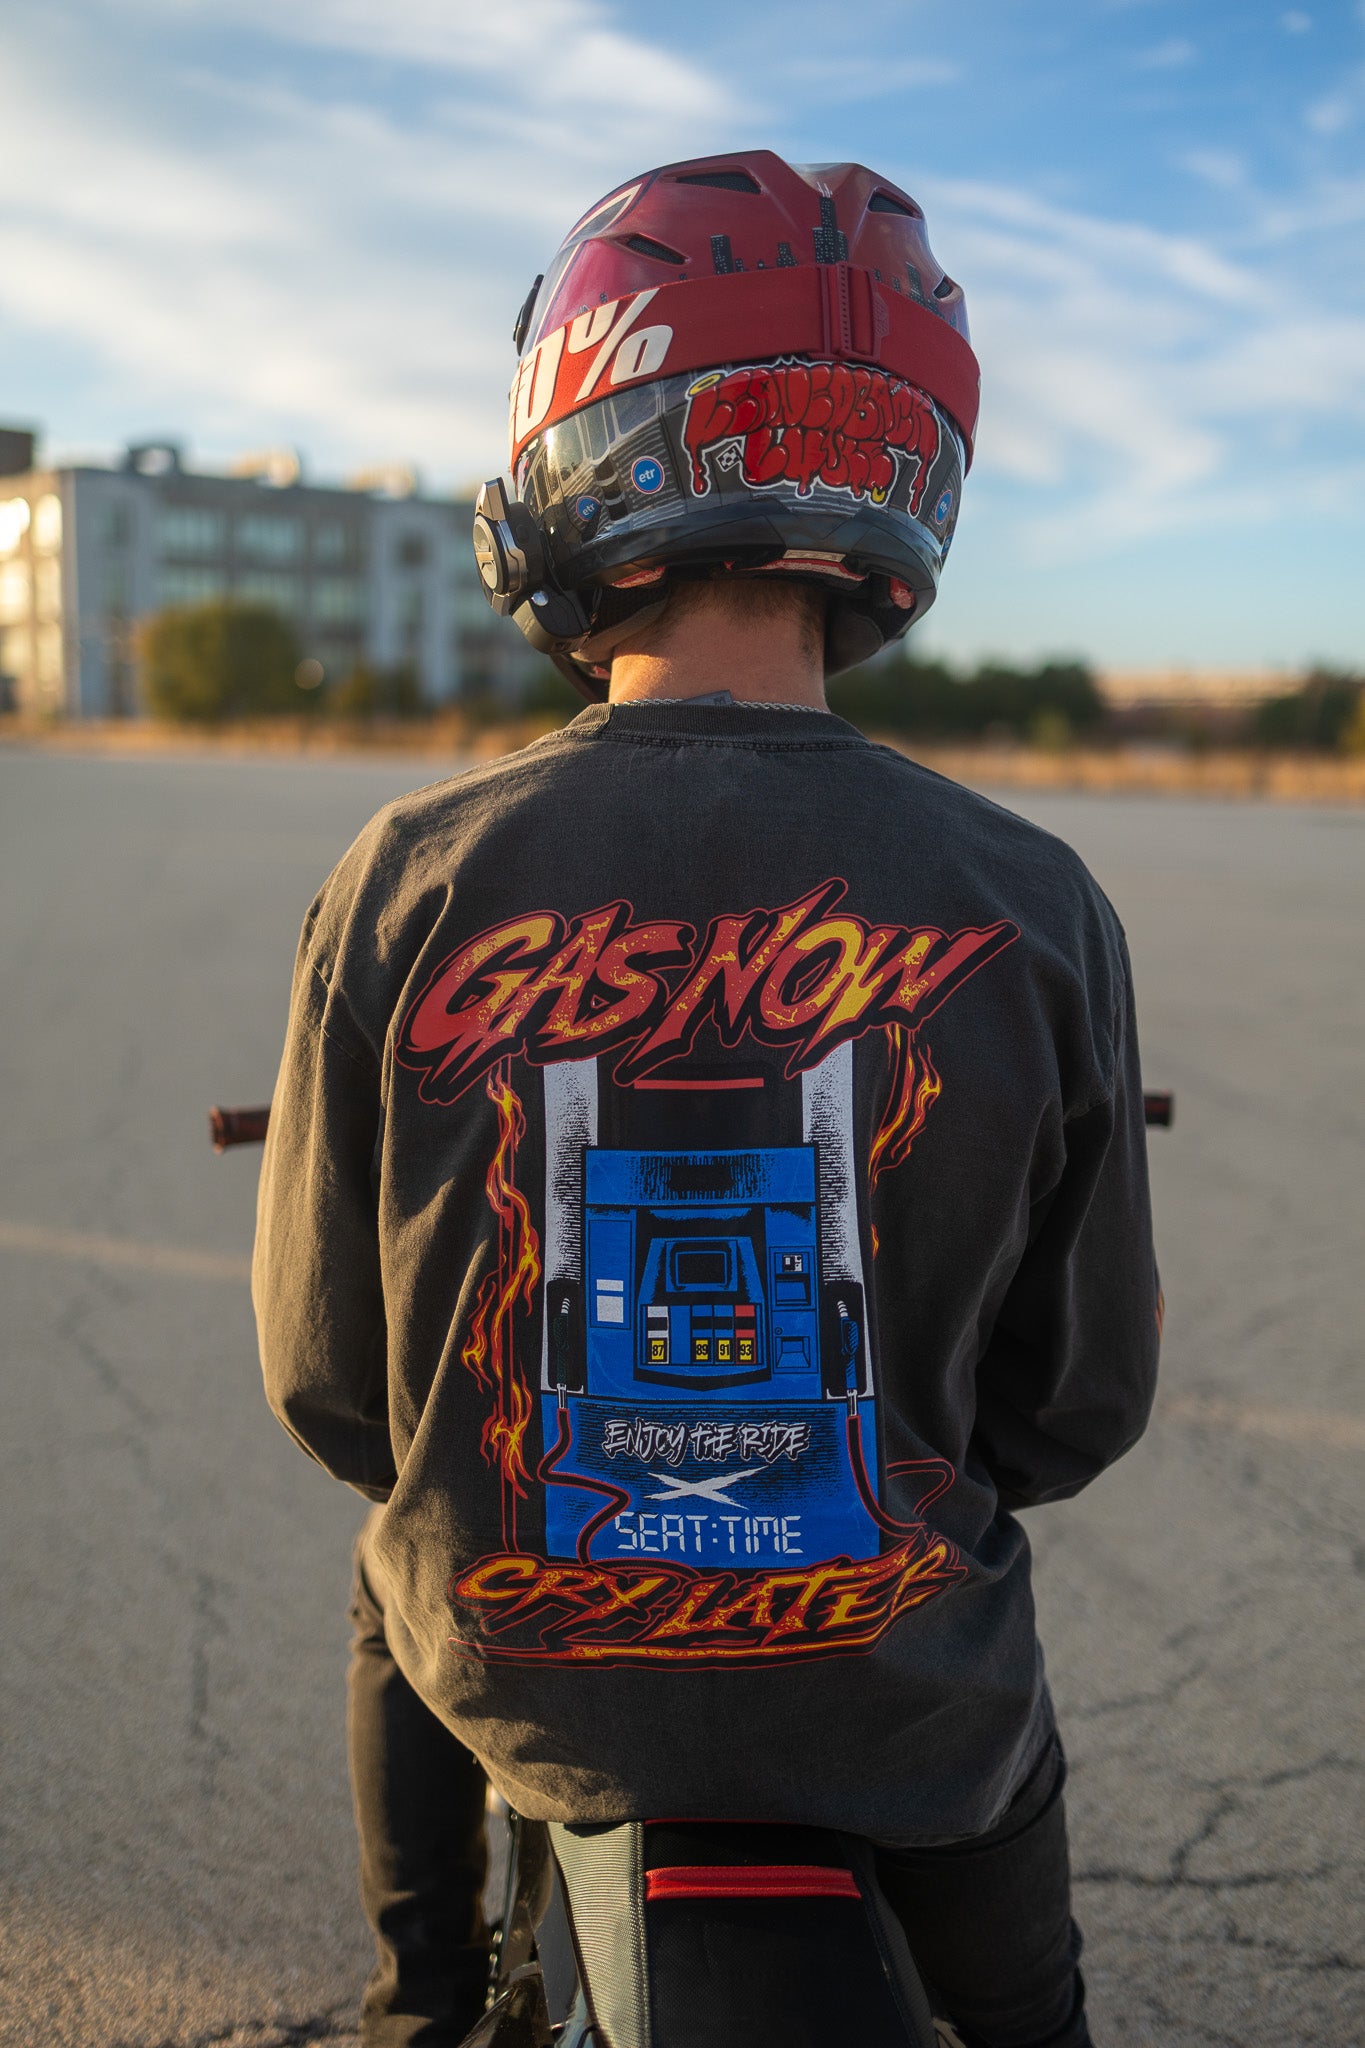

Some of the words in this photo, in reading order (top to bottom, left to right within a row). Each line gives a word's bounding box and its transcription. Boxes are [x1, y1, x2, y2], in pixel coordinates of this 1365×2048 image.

[638, 468, 656, 484] etr
[582, 503, 596, 516] etr
[398, 900, 697, 1098] GAS
[614, 878, 1018, 1084] NOW
[652, 1343, 664, 1356] 87
[695, 1343, 708, 1356] 89
[719, 1343, 730, 1356] 91
[740, 1343, 752, 1356] 93
[604, 1418, 688, 1466] ENJOY
[740, 1423, 810, 1462] RIDE
